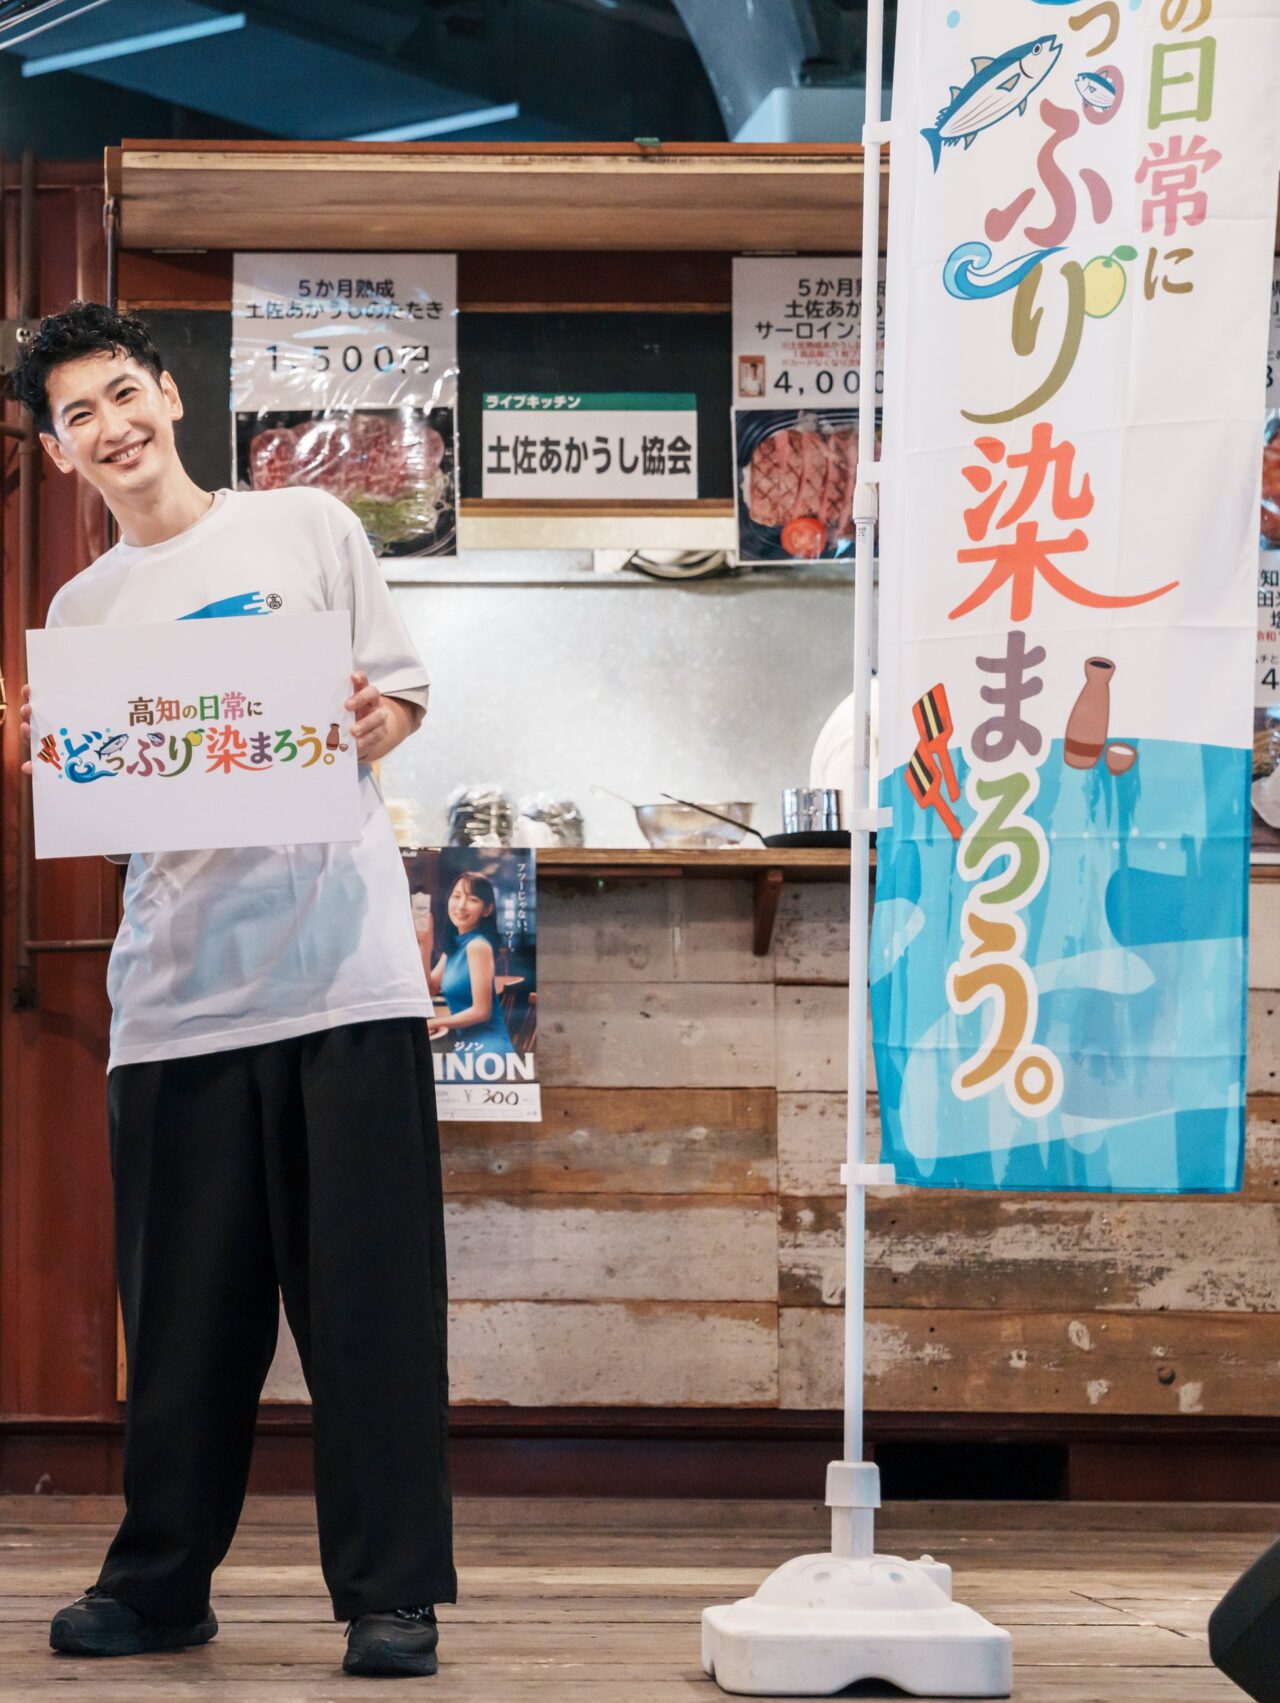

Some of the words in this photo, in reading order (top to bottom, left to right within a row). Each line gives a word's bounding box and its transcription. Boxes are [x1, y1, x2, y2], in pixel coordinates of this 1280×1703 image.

[298, 279, 394, 298] 5か月熟成
[486, 394, 581, 409] ライブキッチン
[487, 436, 692, 475] 土佐あかうし協会
[128, 691, 263, 727] 高知の日常に
[64, 724, 335, 784] どっぷり染まろう。
